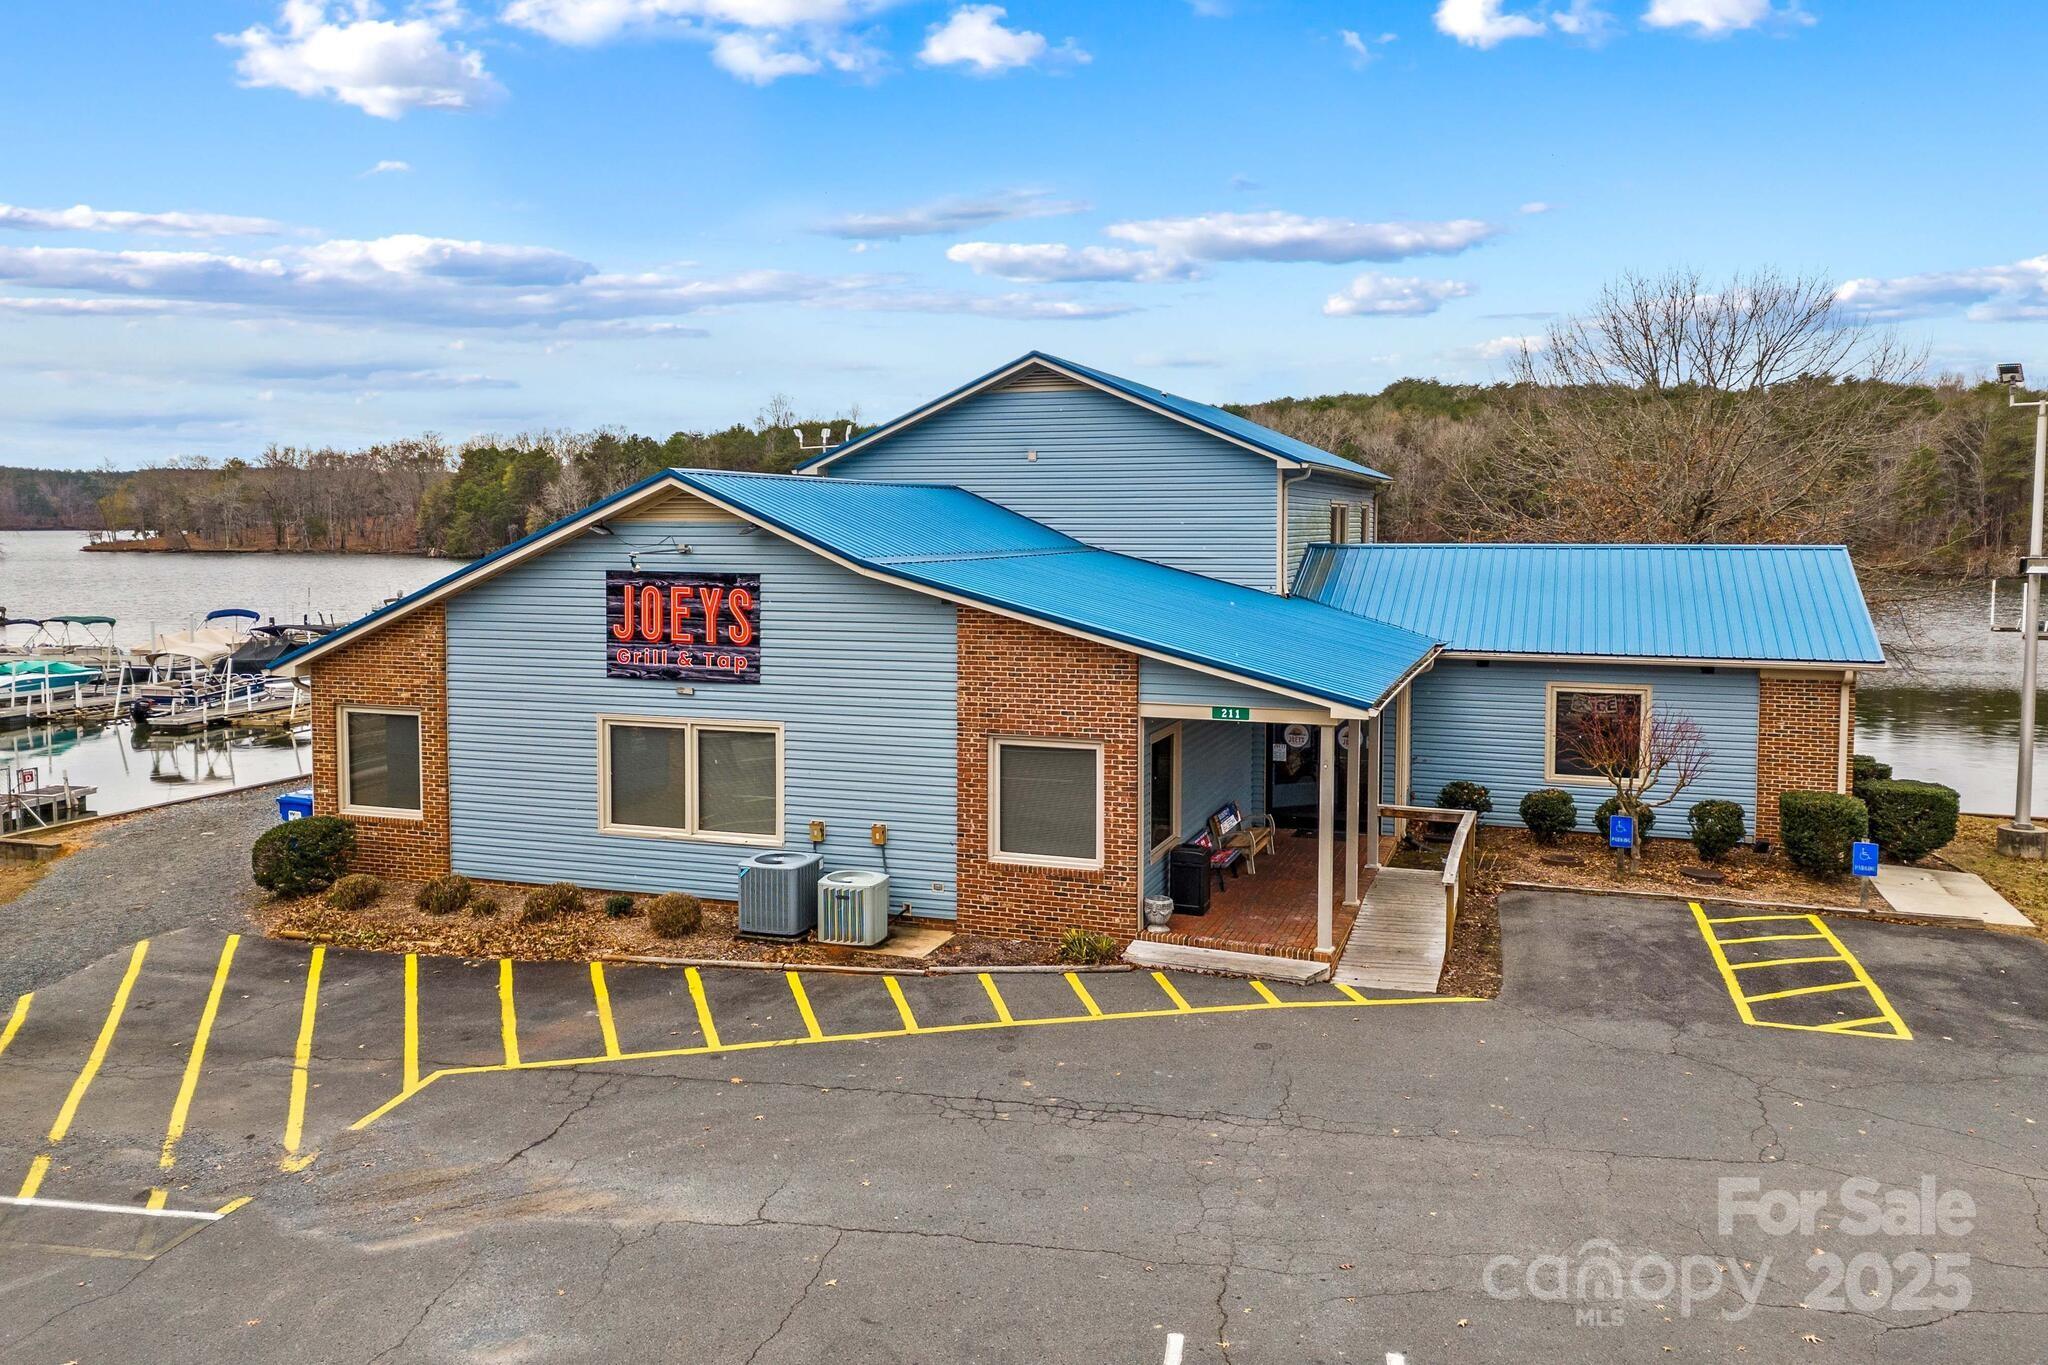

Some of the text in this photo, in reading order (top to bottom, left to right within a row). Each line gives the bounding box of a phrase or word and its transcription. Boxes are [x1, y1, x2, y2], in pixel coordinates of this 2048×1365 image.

[613, 584, 753, 646] JOEYS
[616, 648, 748, 674] Grill & Tap
[1221, 708, 1240, 719] 211
